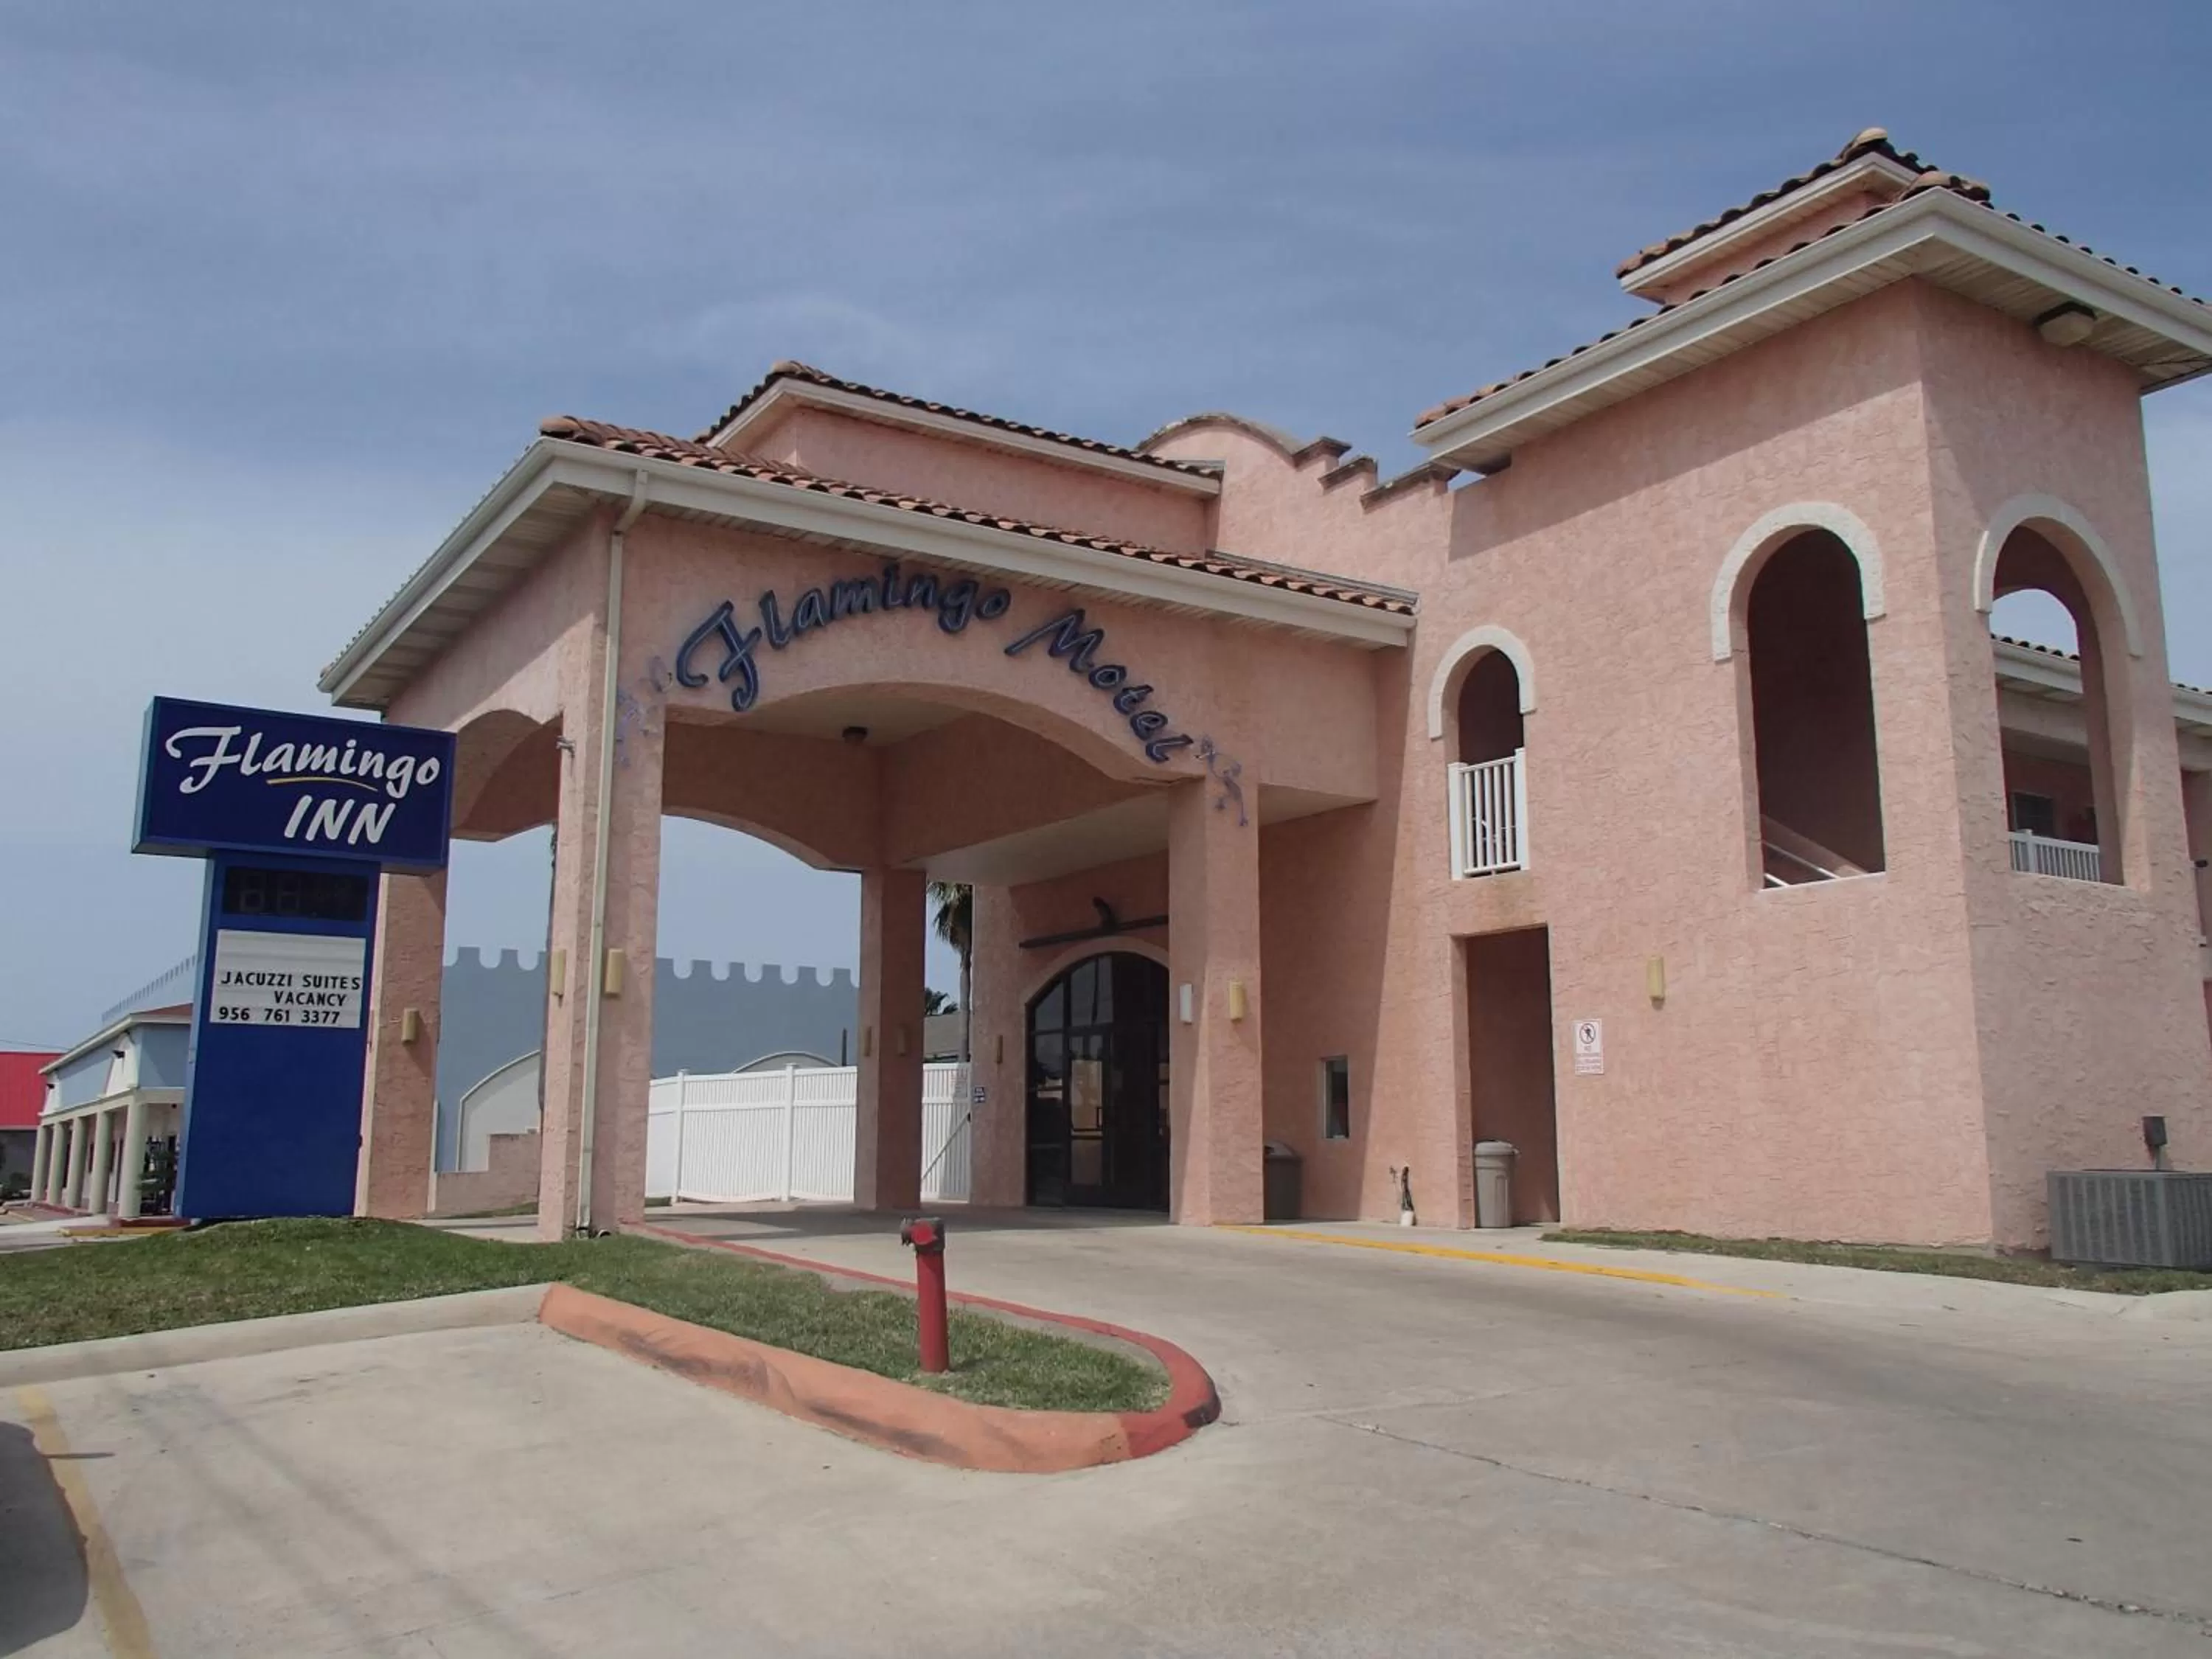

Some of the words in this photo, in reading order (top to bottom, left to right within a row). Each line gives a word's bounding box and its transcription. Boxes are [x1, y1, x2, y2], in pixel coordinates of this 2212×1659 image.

[675, 562, 1012, 712] Flamingo
[1004, 608, 1194, 763] Motel
[165, 725, 441, 799] Flamingo
[284, 794, 396, 846] INN
[221, 970, 292, 987] JACUZZI
[302, 975, 361, 990] SUITES
[274, 990, 347, 1006] VACANCY
[219, 1006, 250, 1021] 956
[264, 1008, 291, 1023] 761
[301, 1010, 340, 1024] 3377
